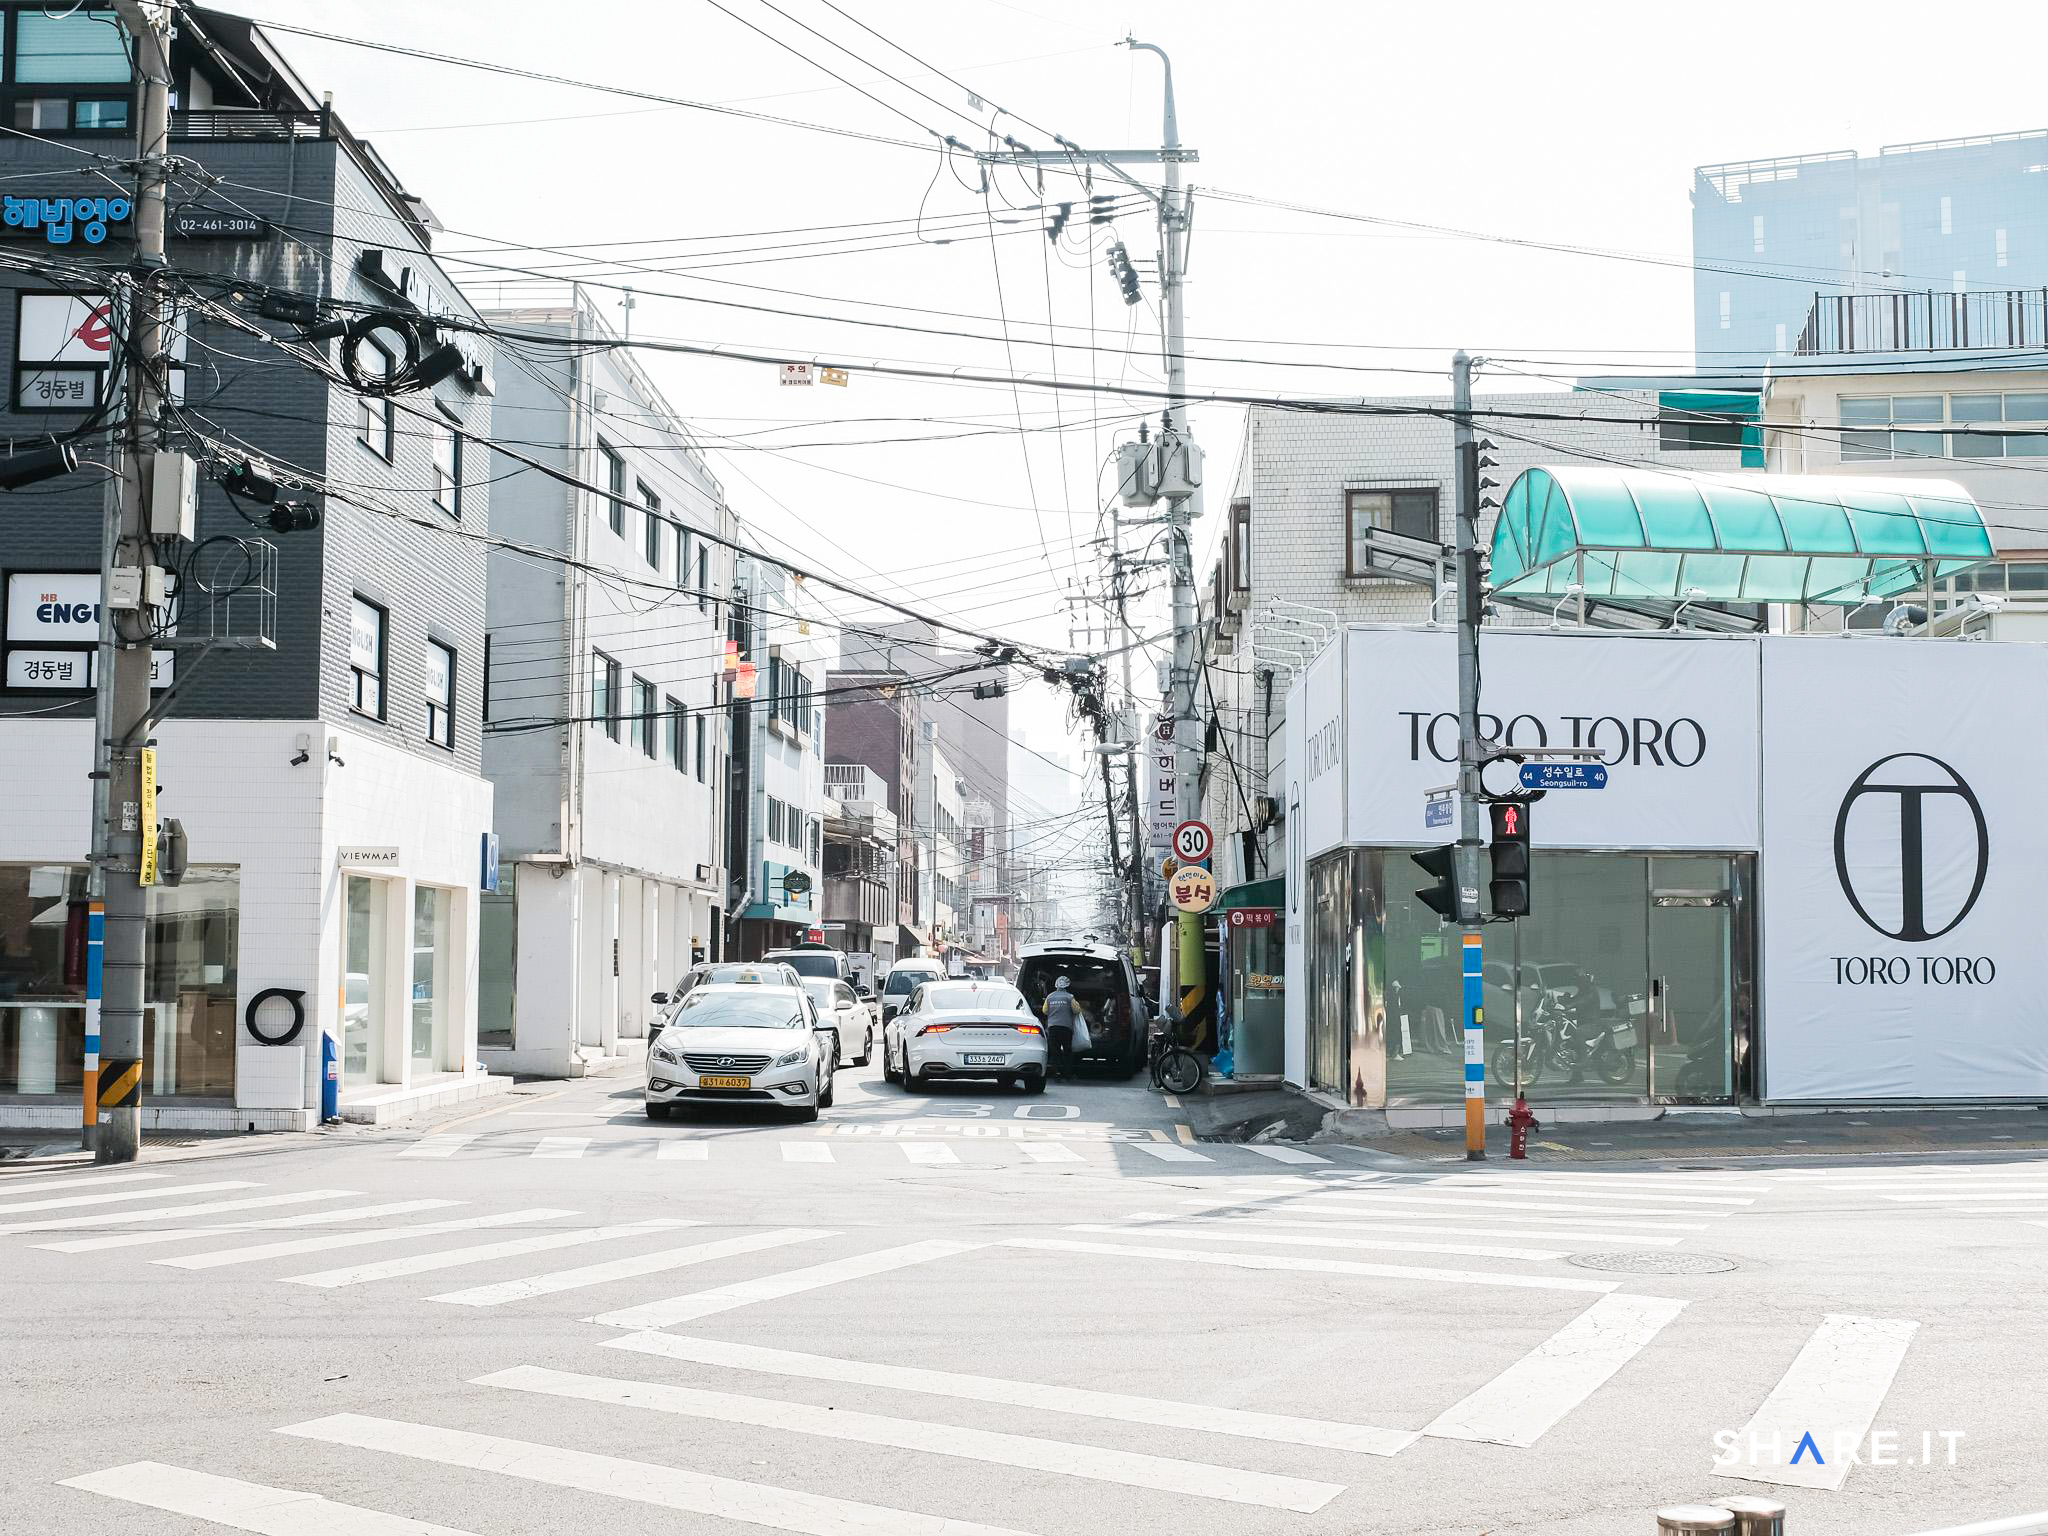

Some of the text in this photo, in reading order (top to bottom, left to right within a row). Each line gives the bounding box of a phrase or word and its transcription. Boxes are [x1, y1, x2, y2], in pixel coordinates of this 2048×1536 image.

[181, 220, 256, 230] 02-461-3014
[1560, 716, 1707, 767] TORO
[1522, 772, 1533, 781] 44
[1542, 766, 1585, 779] 성수일로
[1594, 772, 1605, 781] 40
[1540, 779, 1588, 788] Seongsuil-ro
[1182, 830, 1204, 853] 30
[341, 852, 397, 861] VIEWMAP
[1175, 884, 1211, 904] 분식
[1830, 956, 1996, 985] TORO TORO
[925, 1103, 1081, 1119] 30
